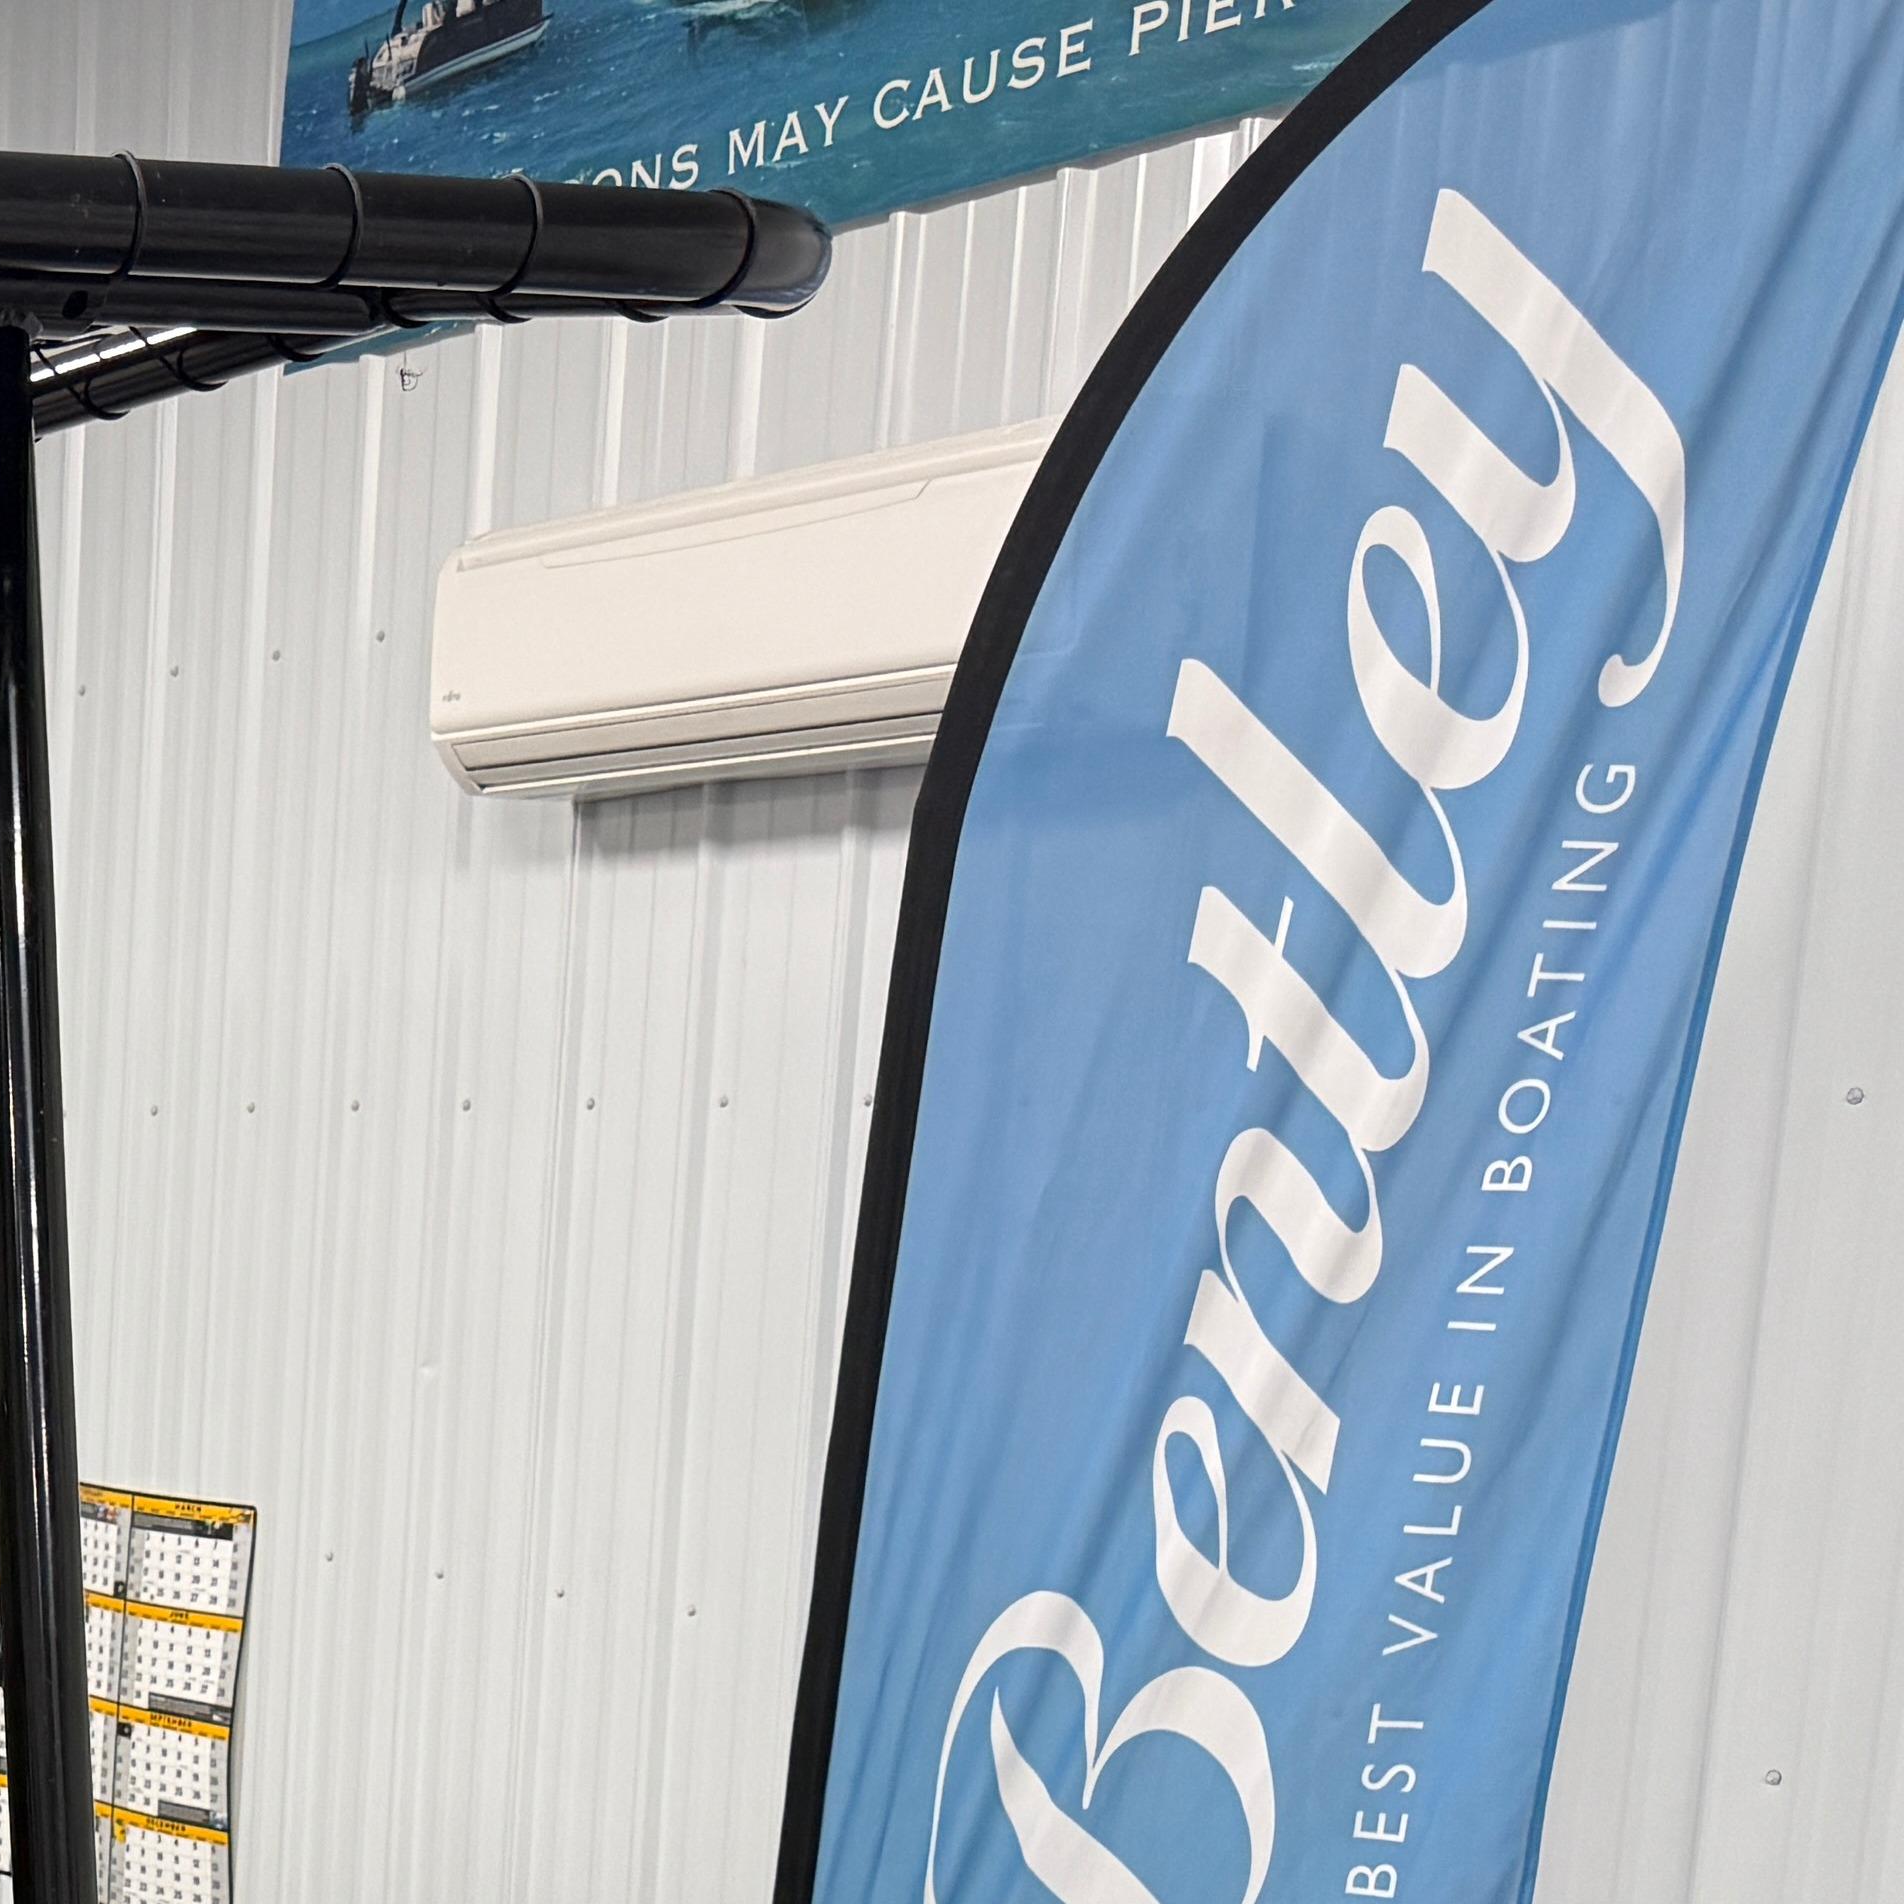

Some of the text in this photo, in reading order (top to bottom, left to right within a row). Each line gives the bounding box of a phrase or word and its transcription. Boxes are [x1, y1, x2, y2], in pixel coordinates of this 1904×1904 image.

[728, 96, 849, 175] MAY
[873, 18, 1094, 129] CAUSE
[1481, 763, 1637, 1193] BOATING
[1448, 1246, 1515, 1333] IN
[1383, 1382, 1484, 1656] VALUE
[1345, 1703, 1424, 1899] BEST
